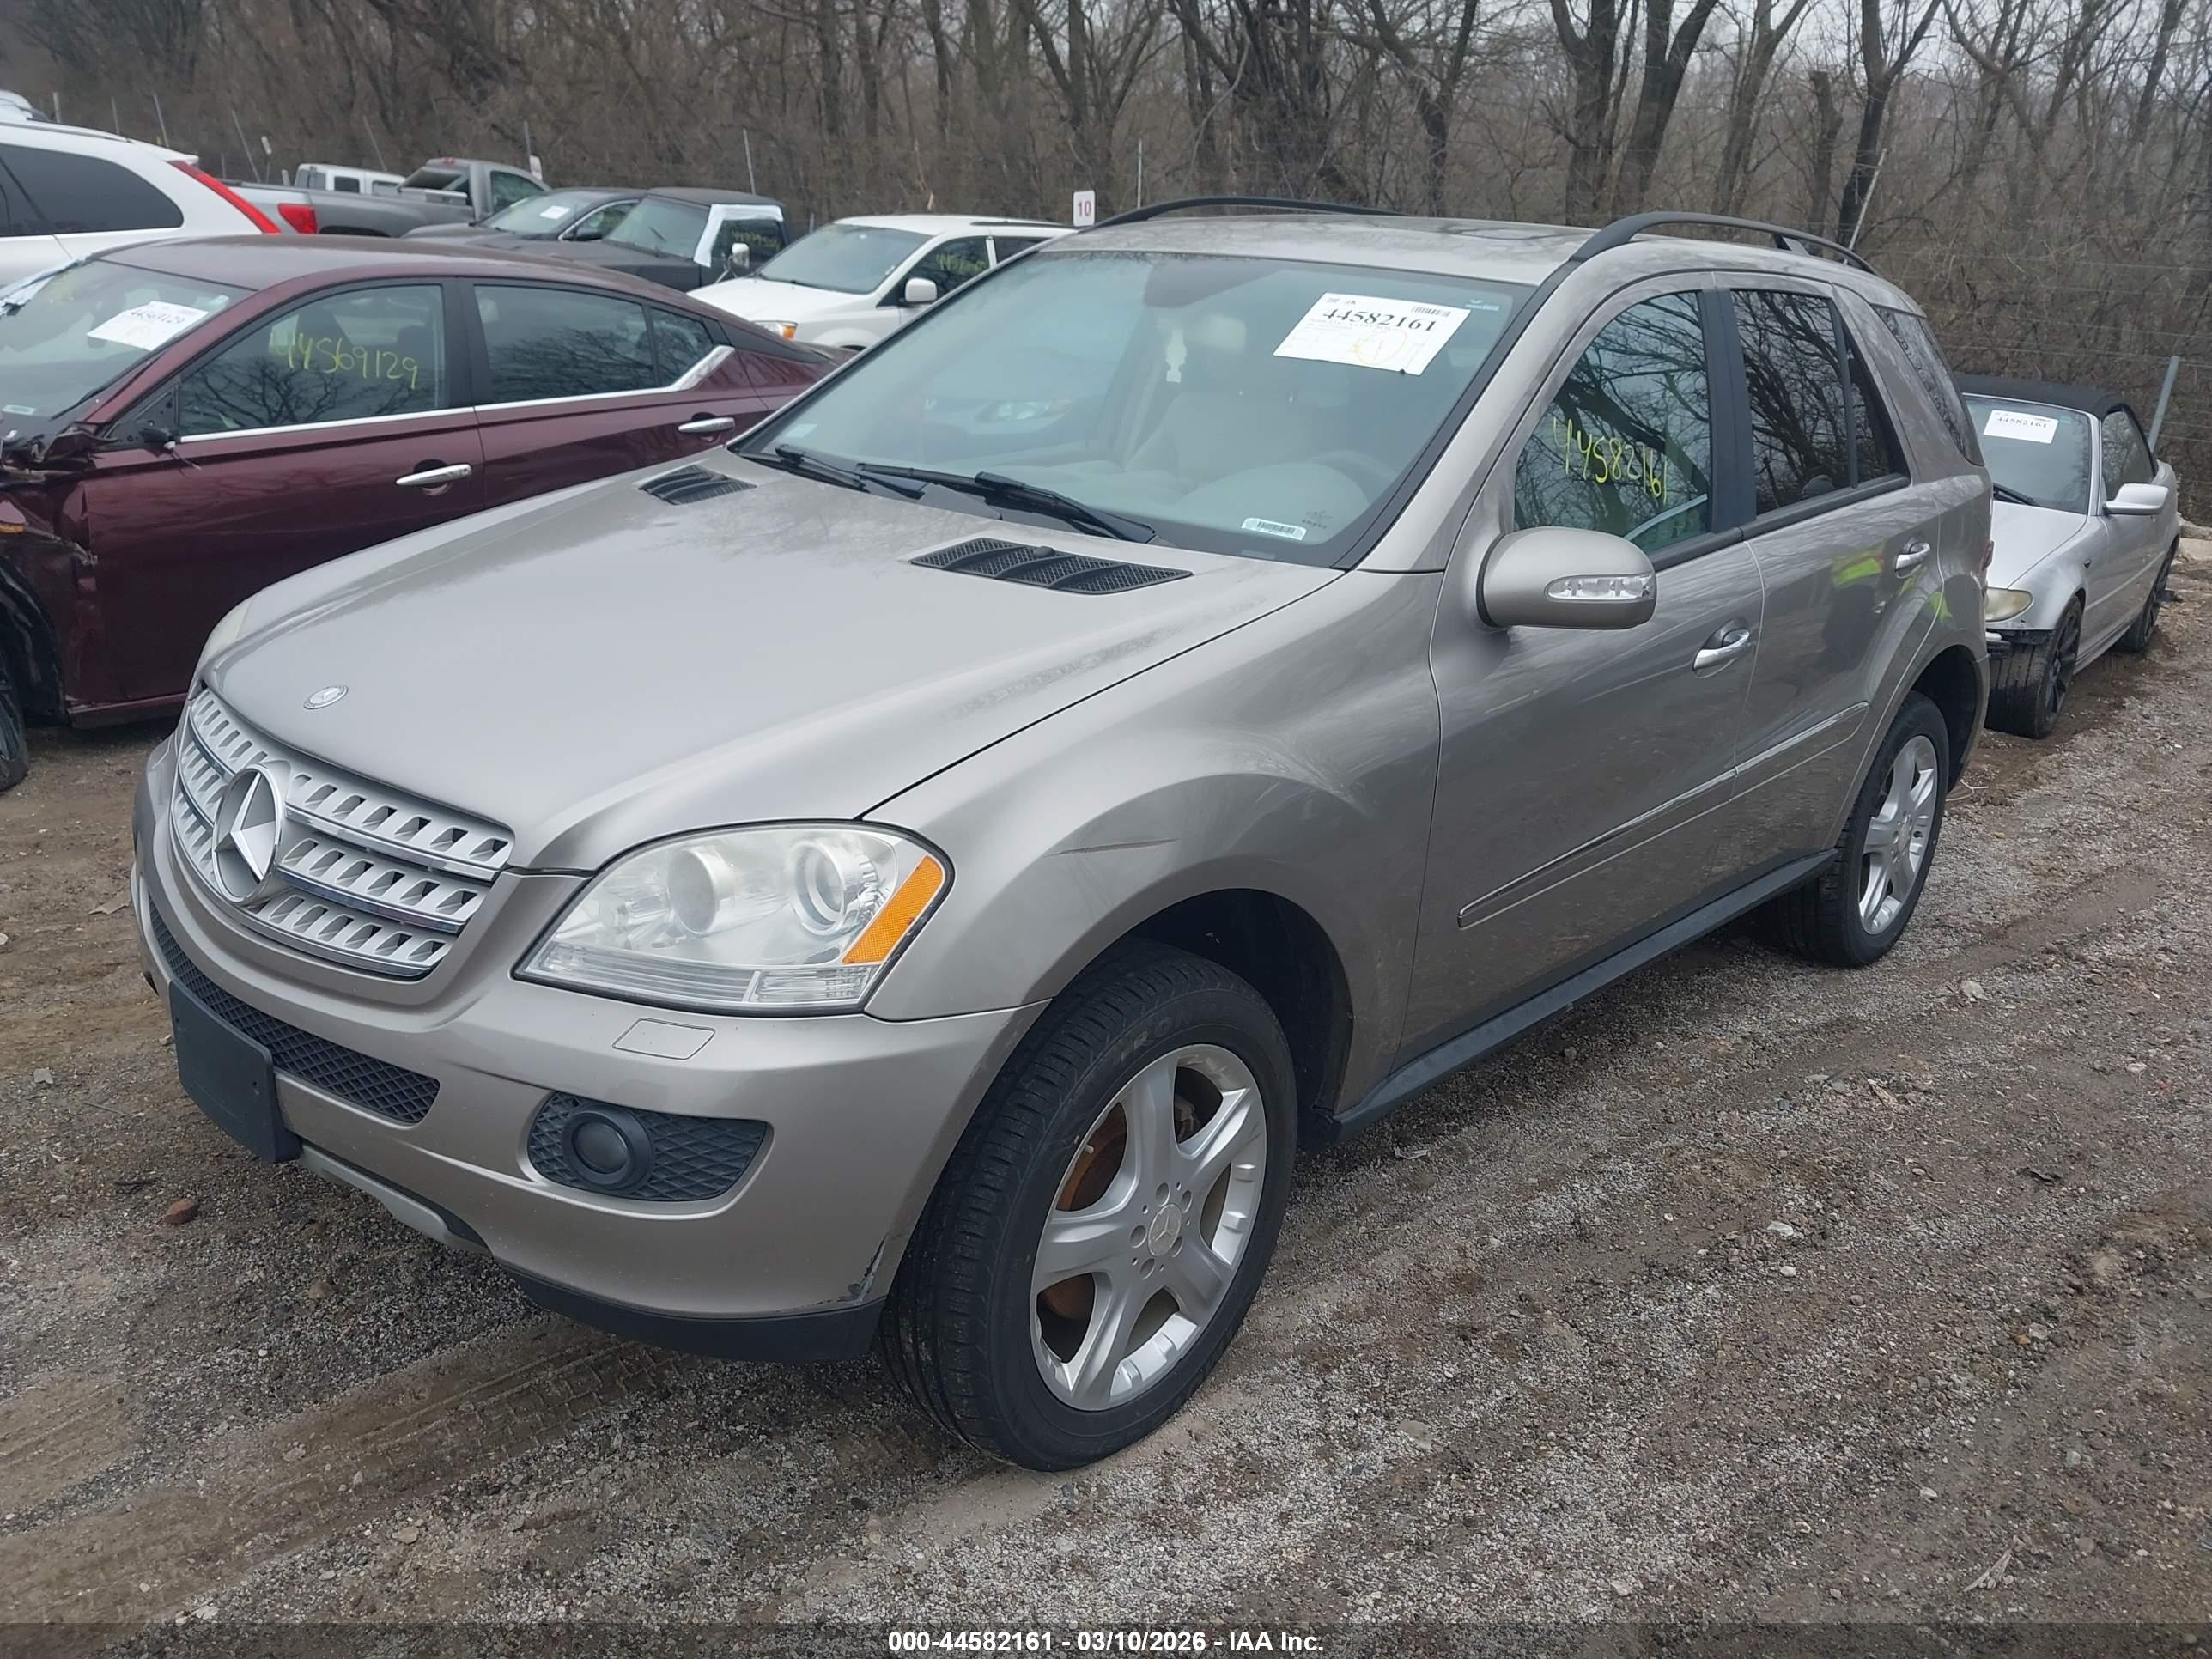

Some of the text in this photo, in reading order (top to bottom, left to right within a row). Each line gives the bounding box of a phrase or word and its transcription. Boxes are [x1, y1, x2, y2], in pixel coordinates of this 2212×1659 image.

[1078, 200, 1092, 216] 10
[1322, 307, 1437, 332] 44582161
[268, 331, 418, 390] 44569129
[1552, 416, 1668, 506] 44582161
